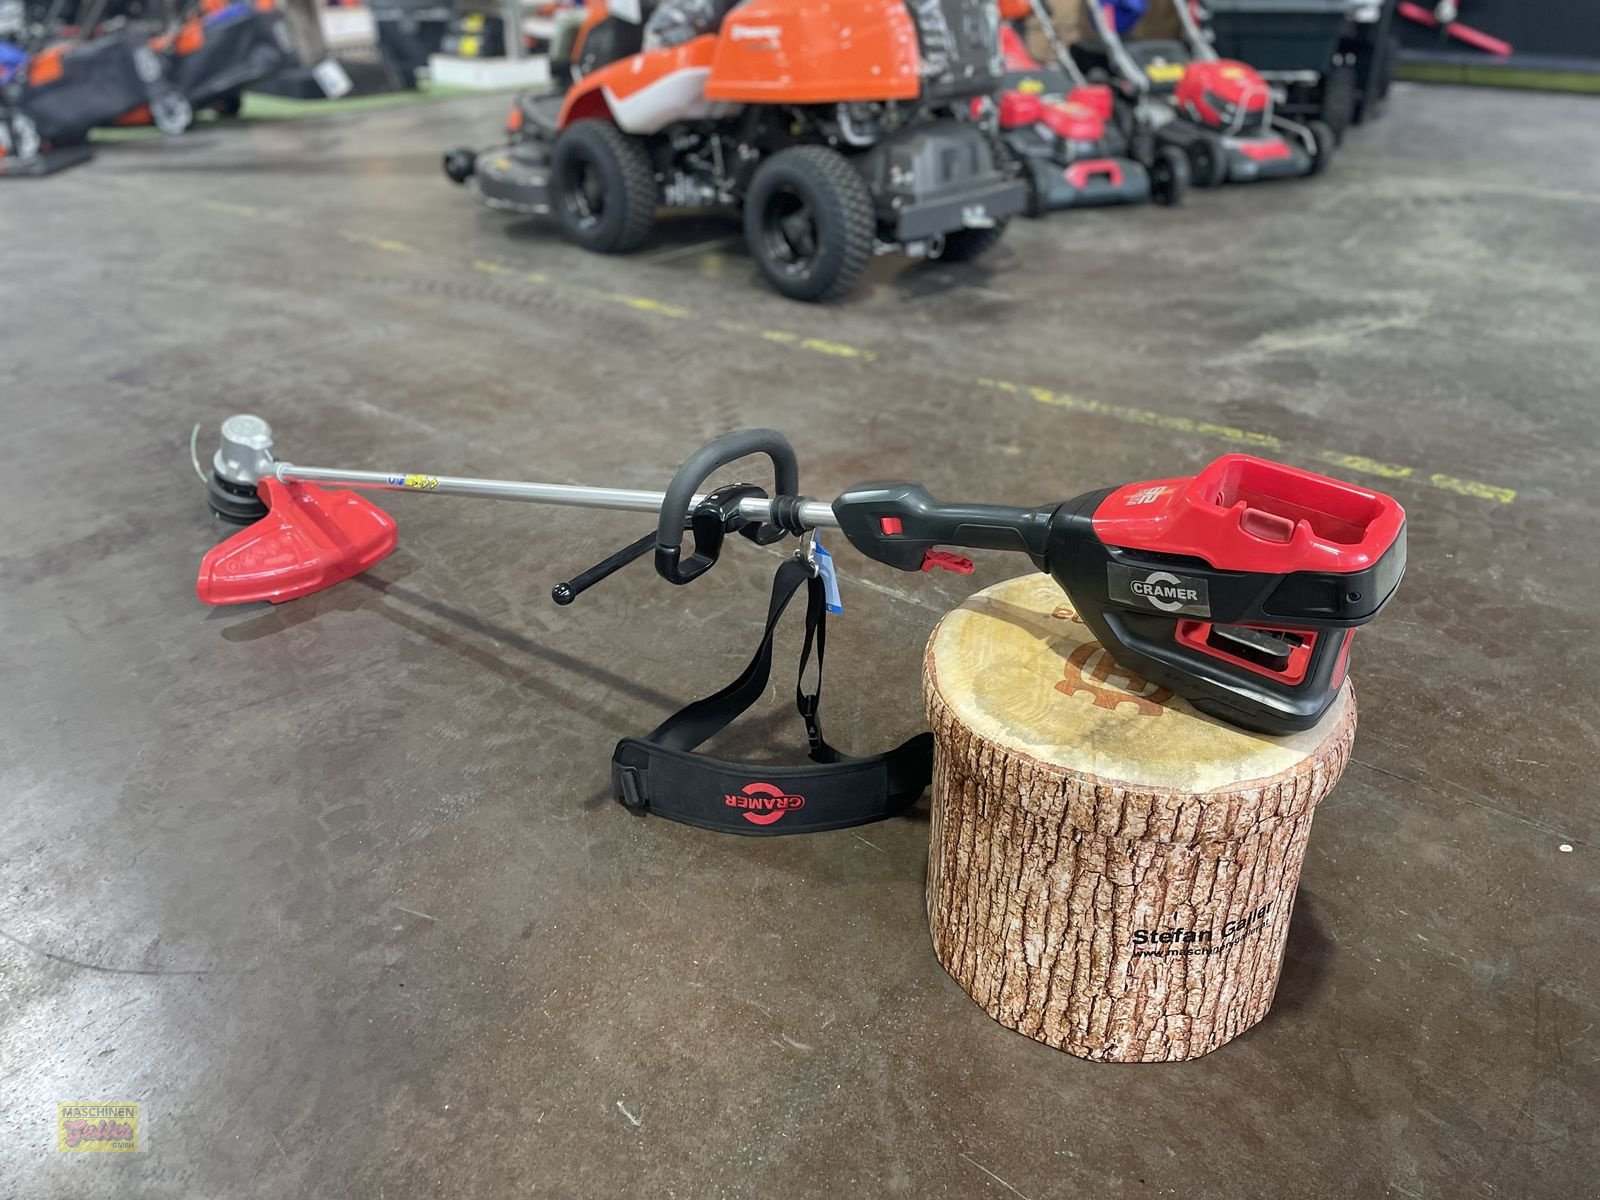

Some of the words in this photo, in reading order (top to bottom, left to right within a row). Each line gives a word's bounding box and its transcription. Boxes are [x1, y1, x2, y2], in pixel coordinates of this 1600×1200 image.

[1133, 583, 1198, 601] CRAMER
[724, 795, 801, 809] CRAMER
[1133, 928, 1212, 944] Stefan
[1221, 901, 1273, 937] Galler
